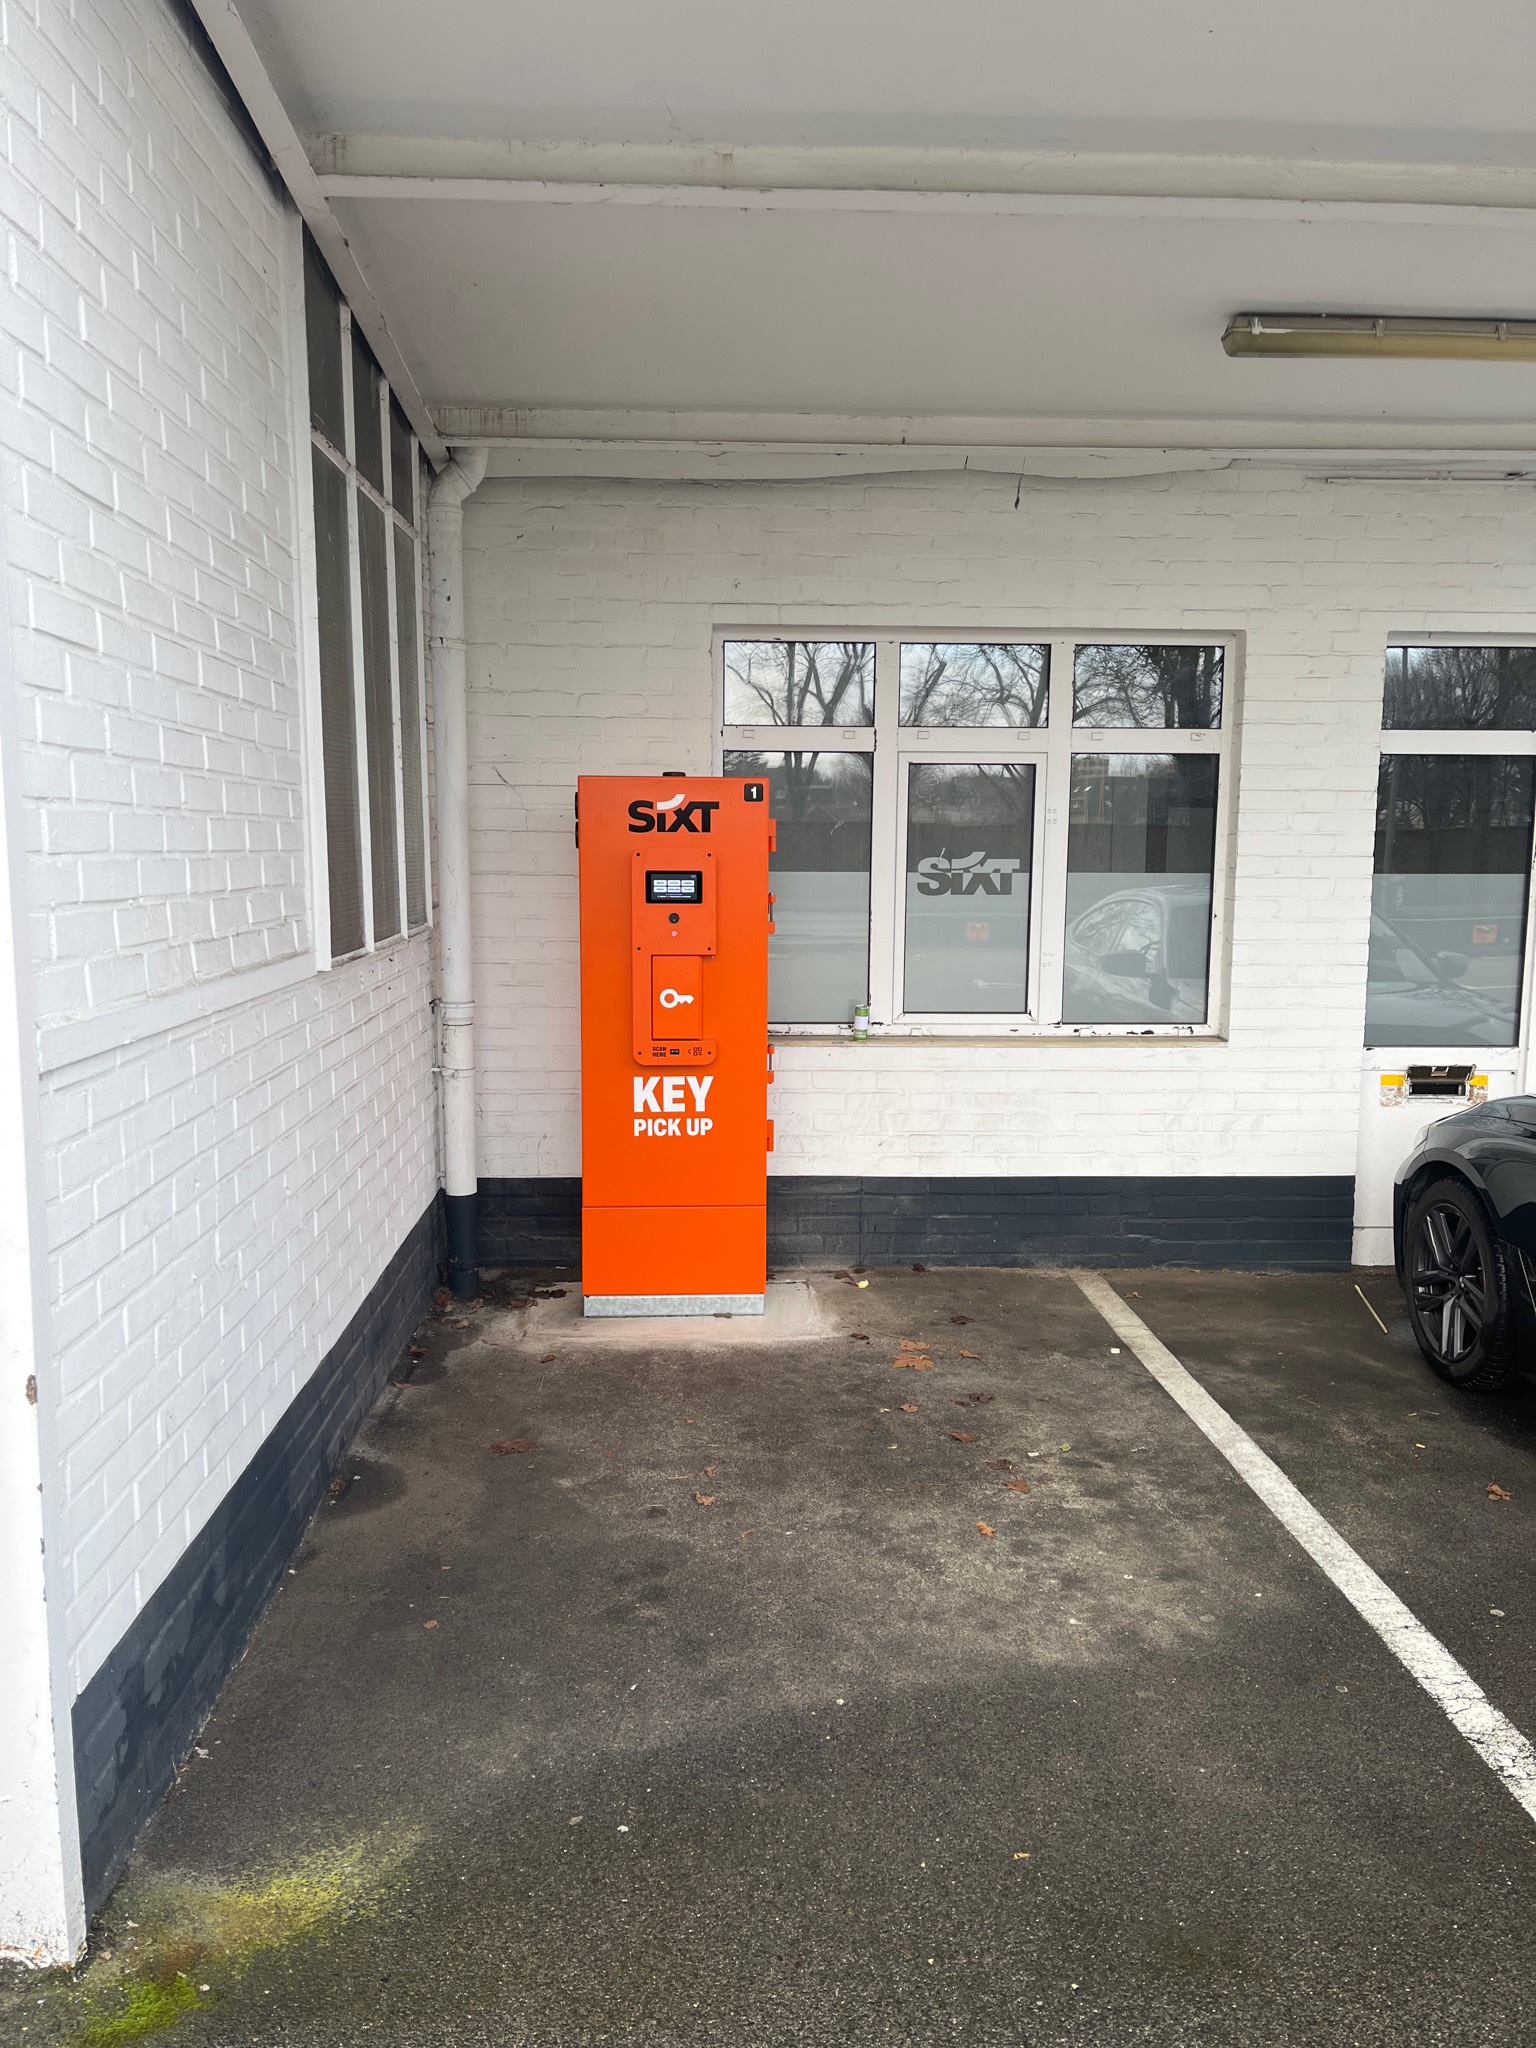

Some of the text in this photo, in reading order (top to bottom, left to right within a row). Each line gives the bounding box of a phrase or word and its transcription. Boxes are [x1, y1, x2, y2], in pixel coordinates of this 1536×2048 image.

[750, 786, 758, 799] 1
[633, 1076, 714, 1112] KEY
[633, 1118, 713, 1137] PICK UP
